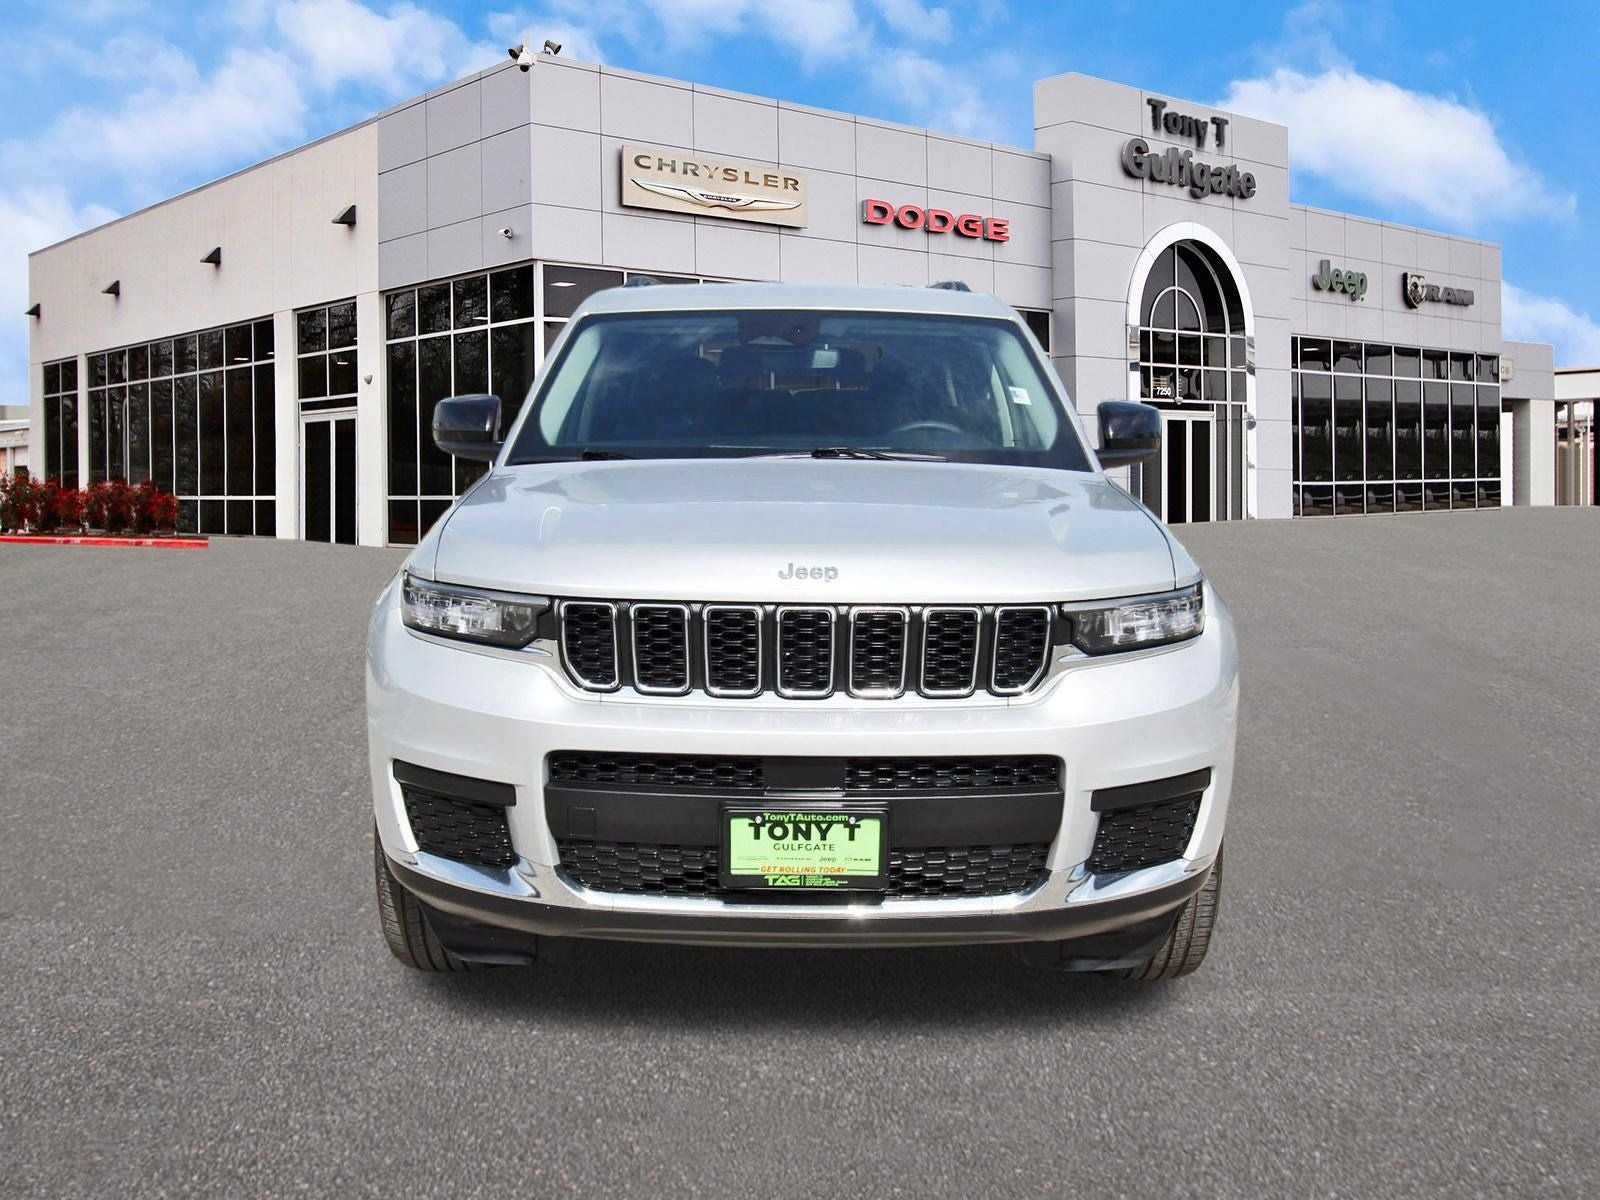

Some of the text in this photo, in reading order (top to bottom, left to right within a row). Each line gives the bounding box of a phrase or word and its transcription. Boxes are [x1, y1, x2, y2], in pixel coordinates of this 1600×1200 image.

[1147, 98, 1229, 147] Tony T
[633, 154, 800, 192] CHRYSLER
[1122, 138, 1256, 199] Gulfgate
[862, 198, 1010, 242] DODGE
[1313, 259, 1368, 301] Jeep
[1425, 284, 1475, 306] RAM
[1156, 387, 1171, 396] 7250
[778, 563, 839, 582] Jeep
[763, 813, 849, 822] TonyTAuto.com
[748, 822, 861, 841] TONY T
[773, 843, 835, 851] GULFGATE
[819, 866, 846, 874] TODAY
[764, 875, 801, 886] TAG
